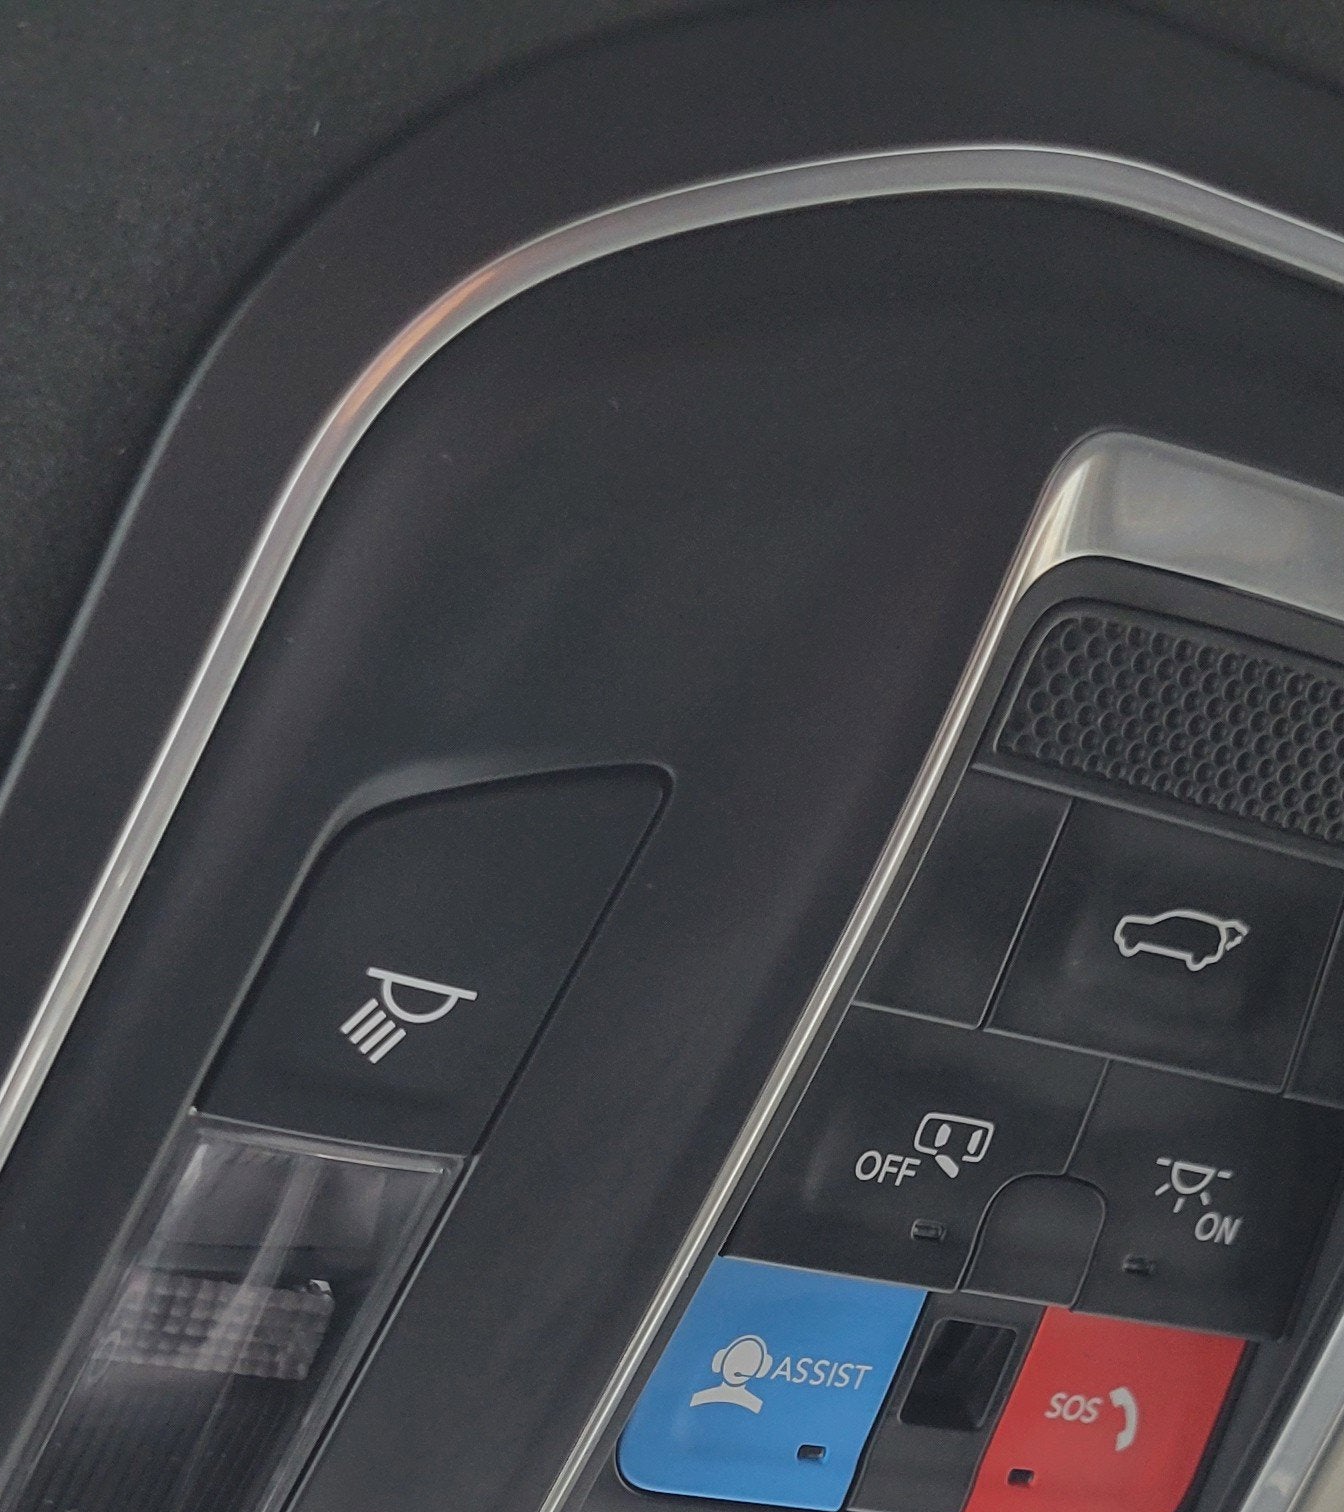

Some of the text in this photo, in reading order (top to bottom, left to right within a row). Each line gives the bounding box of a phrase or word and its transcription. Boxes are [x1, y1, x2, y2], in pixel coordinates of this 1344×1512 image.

[855, 1150, 921, 1188] OFF
[1194, 1211, 1243, 1246] ON
[769, 1356, 873, 1391] ASSIST
[1044, 1391, 1102, 1425] SOS
